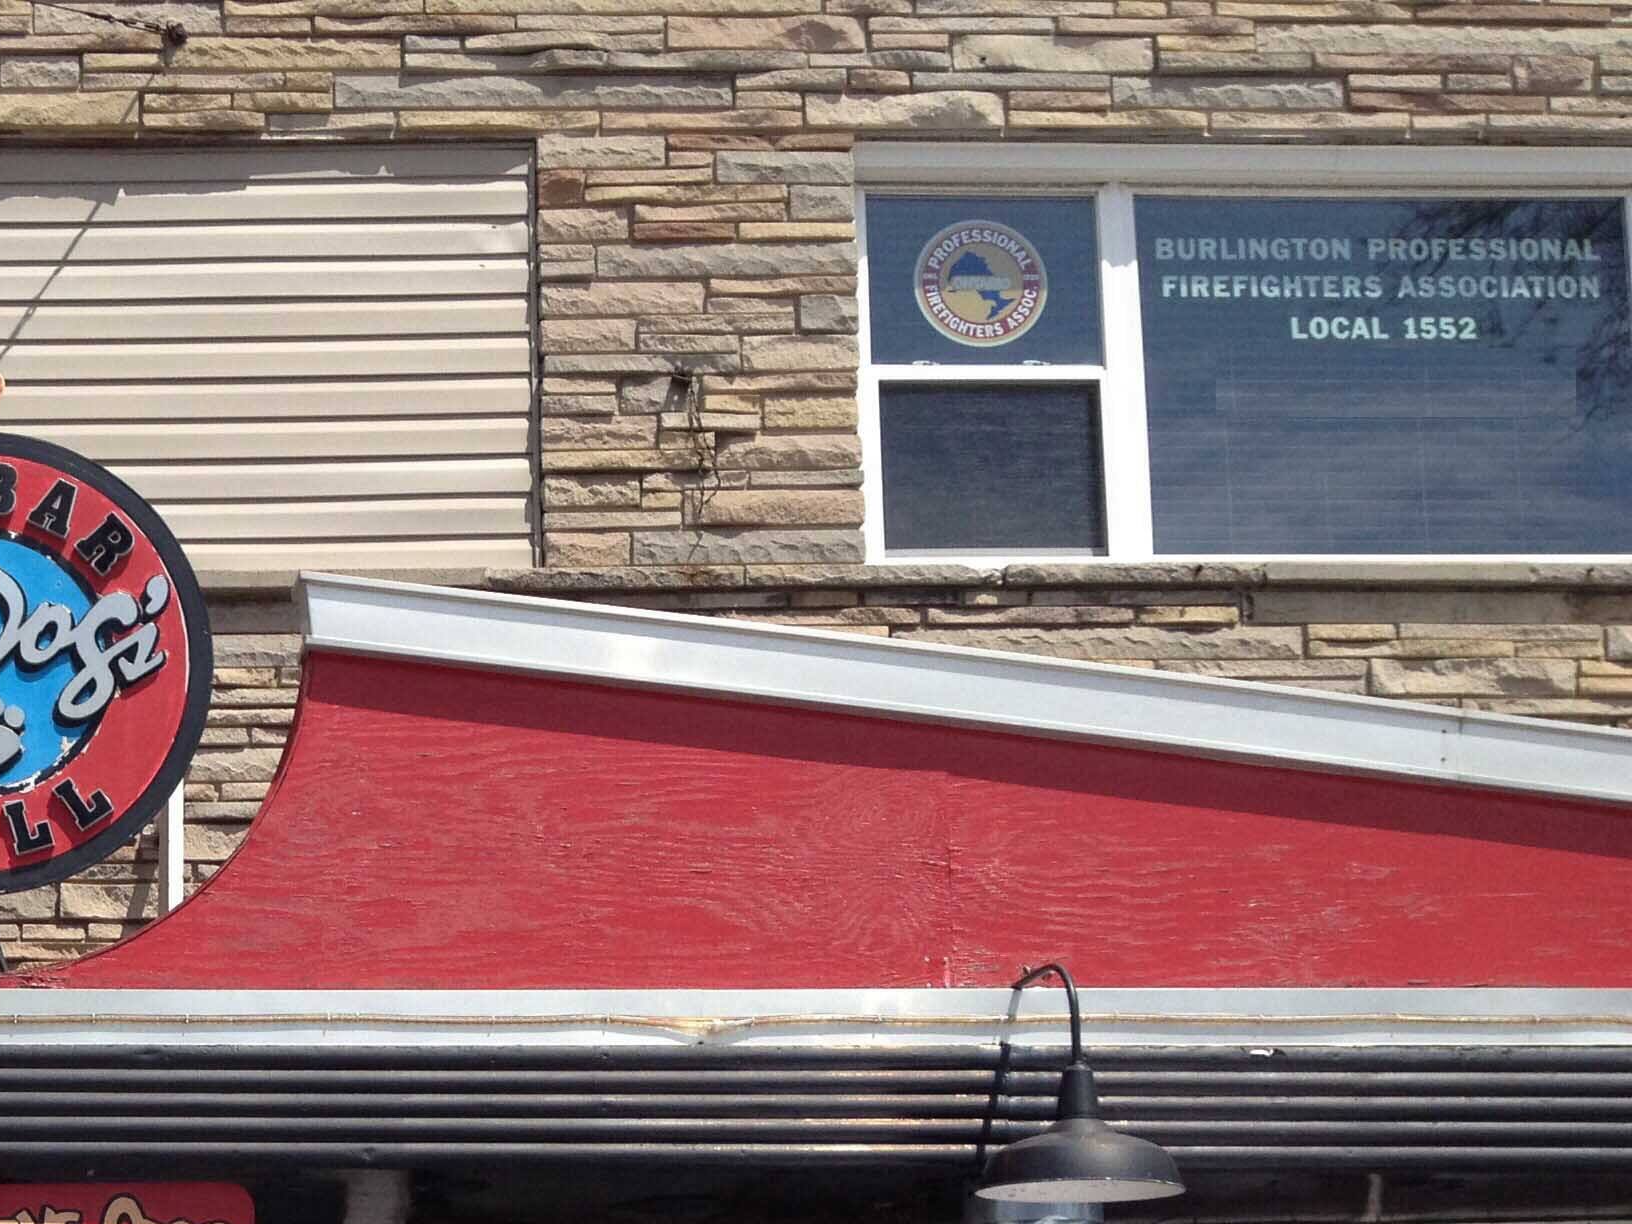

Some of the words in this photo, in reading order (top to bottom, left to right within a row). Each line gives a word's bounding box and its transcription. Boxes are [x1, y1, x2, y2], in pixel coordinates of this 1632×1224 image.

[928, 229, 1033, 270] PROFESSIONAL
[1154, 238, 1352, 261] BURLINGTON
[1368, 238, 1602, 261] PROFESSIONAL
[1161, 275, 1383, 299] FIREFIGHTERS
[1397, 275, 1602, 299] ASSOCIATION
[925, 284, 1005, 339] FIREFIGHTERS
[1290, 316, 1390, 340] LOCAL
[1403, 316, 1478, 340] 1552
